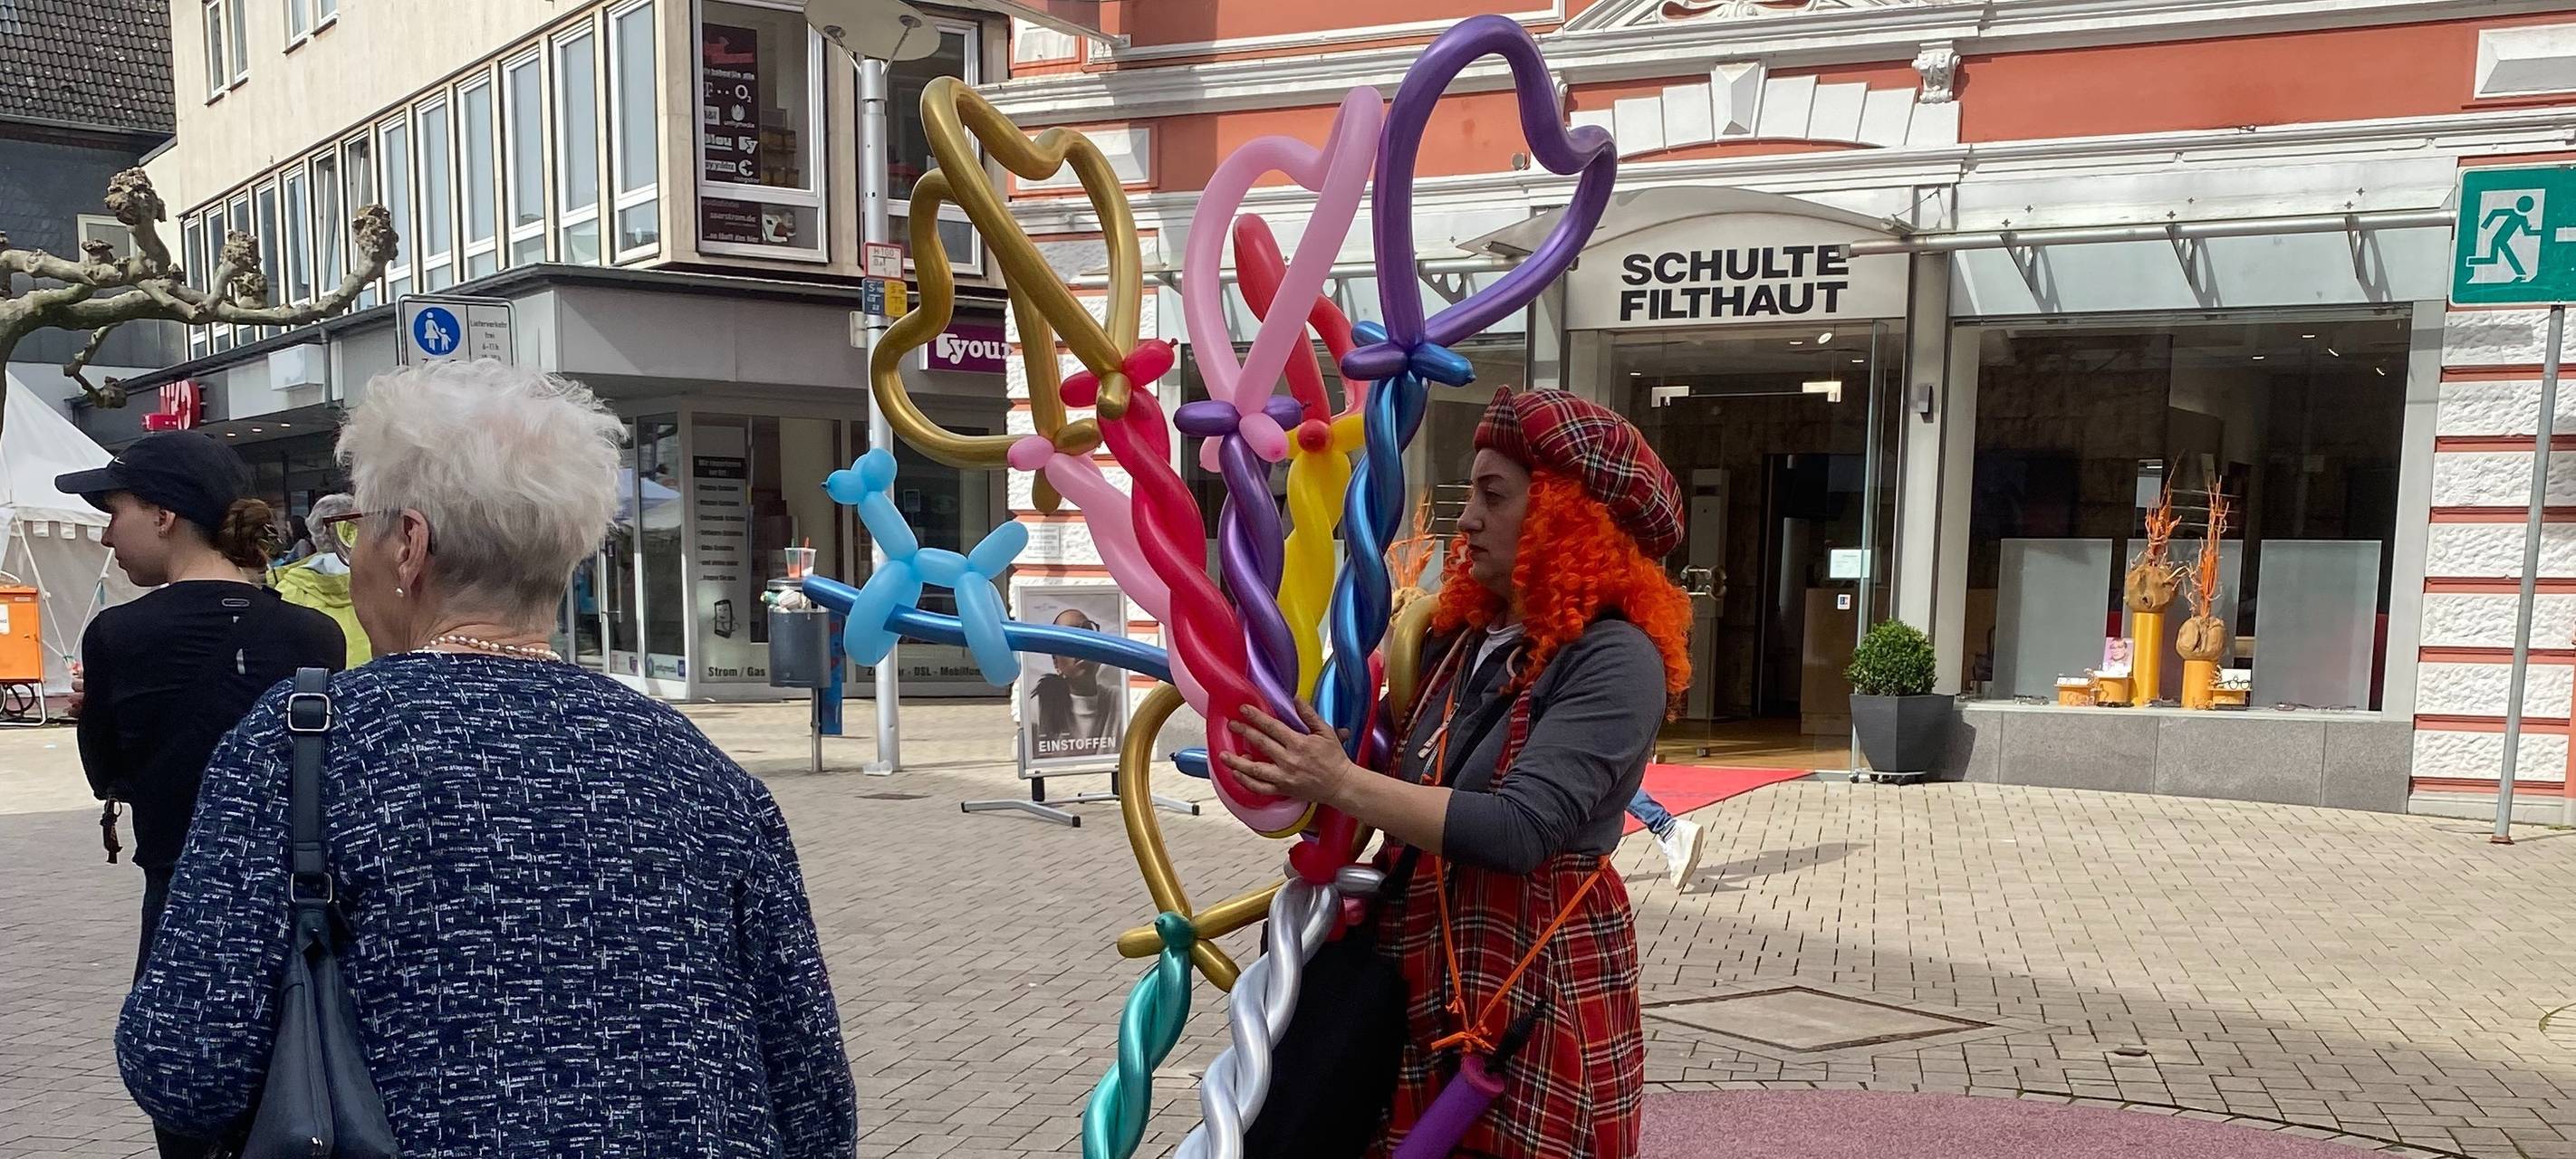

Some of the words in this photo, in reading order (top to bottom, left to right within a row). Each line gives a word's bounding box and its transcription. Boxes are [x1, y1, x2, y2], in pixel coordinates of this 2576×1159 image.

[1621, 244, 1849, 286] SCHULTE
[1620, 281, 1849, 321] FILTHAUT
[708, 666, 737, 677] Strom
[746, 666, 766, 677] Gas
[914, 666, 931, 676] DSL
[940, 666, 981, 677] Mobilfun
[1038, 737, 1117, 752] EINSTOFFEN
